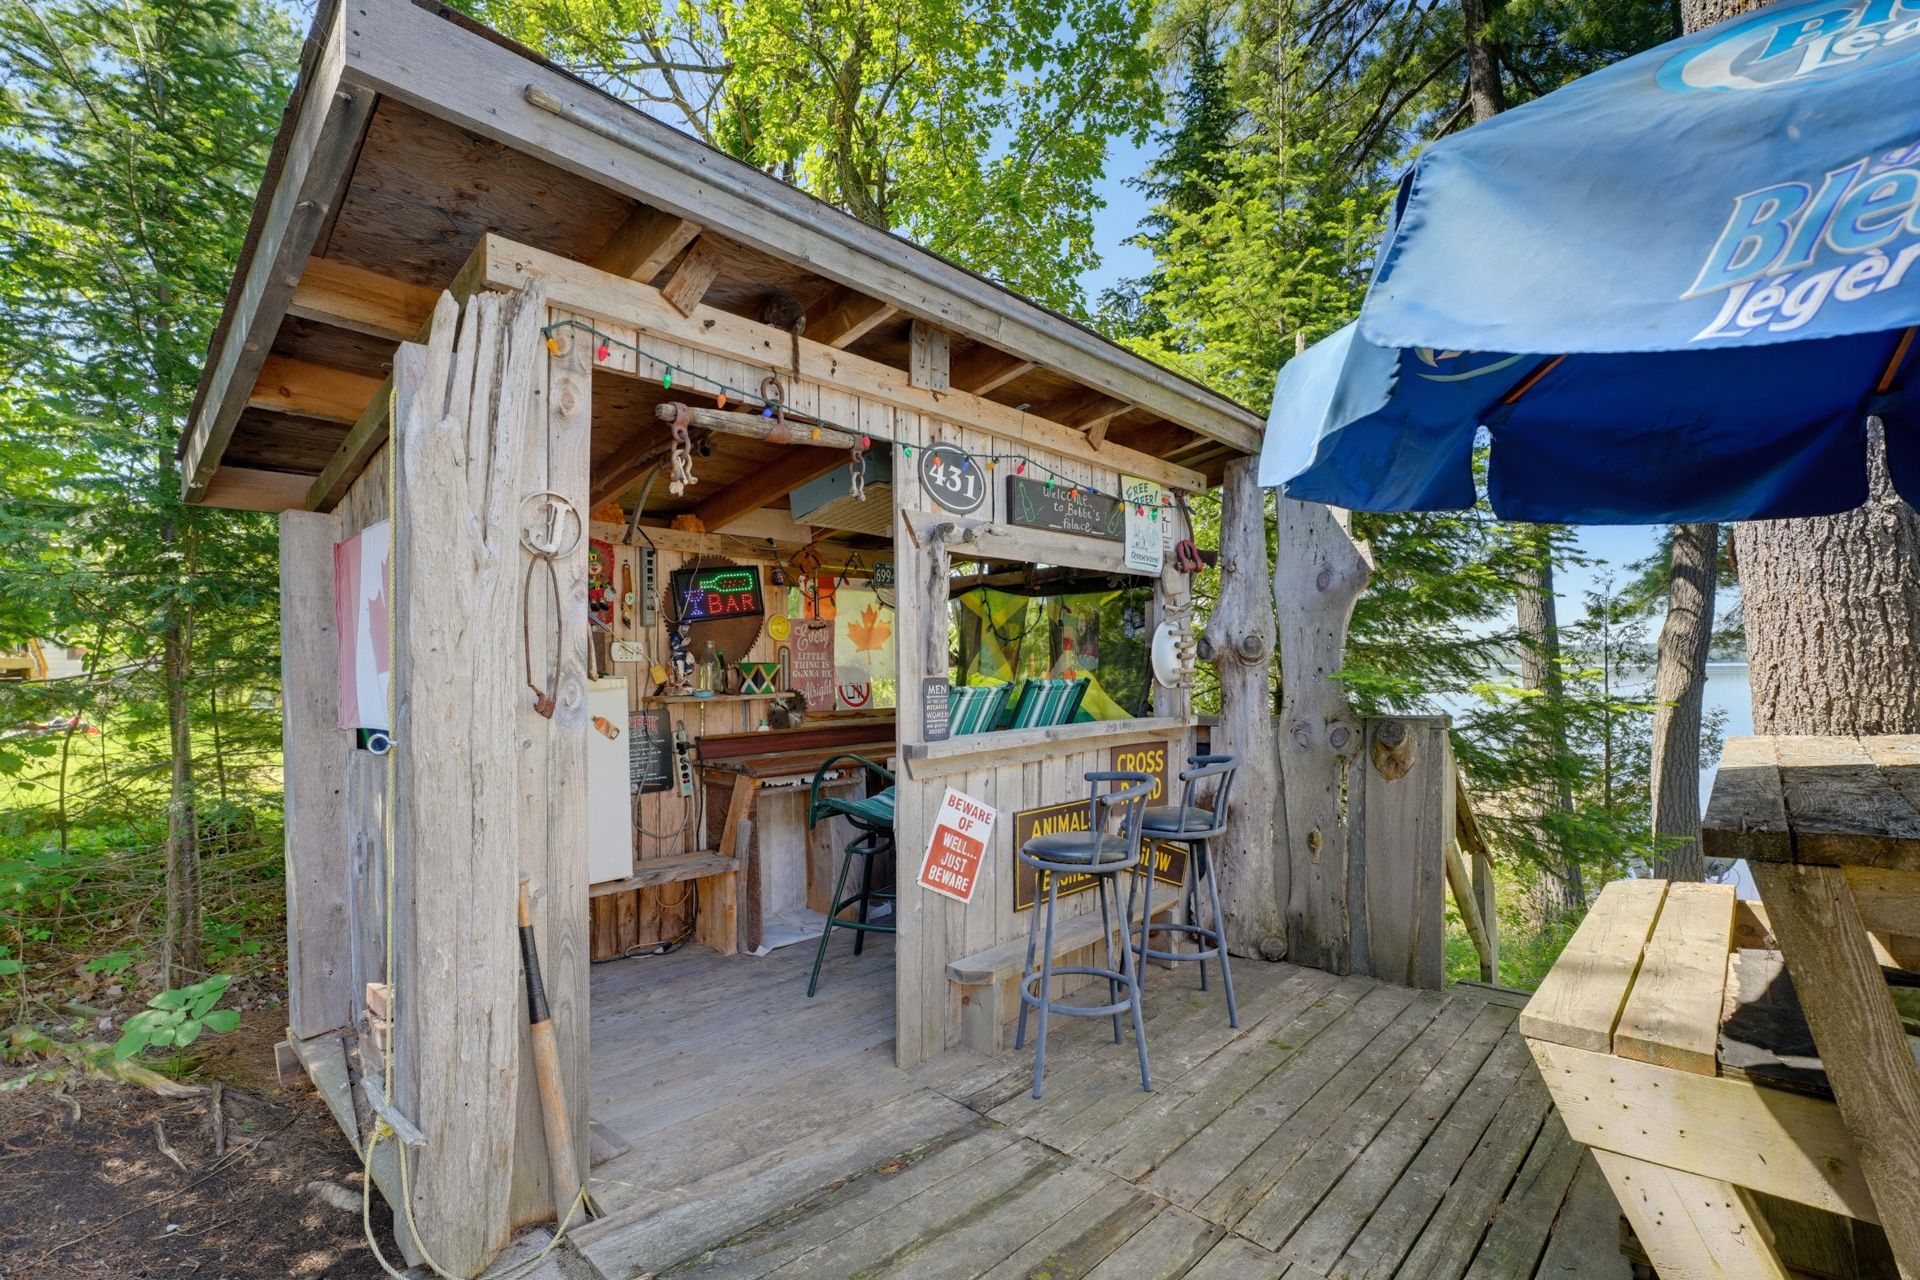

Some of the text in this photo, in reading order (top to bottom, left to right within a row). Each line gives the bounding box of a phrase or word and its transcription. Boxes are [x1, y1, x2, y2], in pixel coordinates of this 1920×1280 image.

[929, 462, 977, 500] 431
[1126, 483, 1149, 499] FREE
[1042, 486, 1093, 509] Welcome
[1053, 501, 1064, 512] to
[708, 592, 755, 614] BAR
[794, 623, 830, 651] Every
[794, 660, 830, 669] THING IS
[798, 652, 827, 660] LITTLE
[928, 684, 947, 695] MEN
[1117, 750, 1164, 773] CROSS
[947, 793, 992, 825] BEWARE
[958, 816, 974, 832] OF
[943, 832, 977, 860] WELL...
[941, 852, 968, 873] JUST
[928, 864, 970, 893] BEWARE
